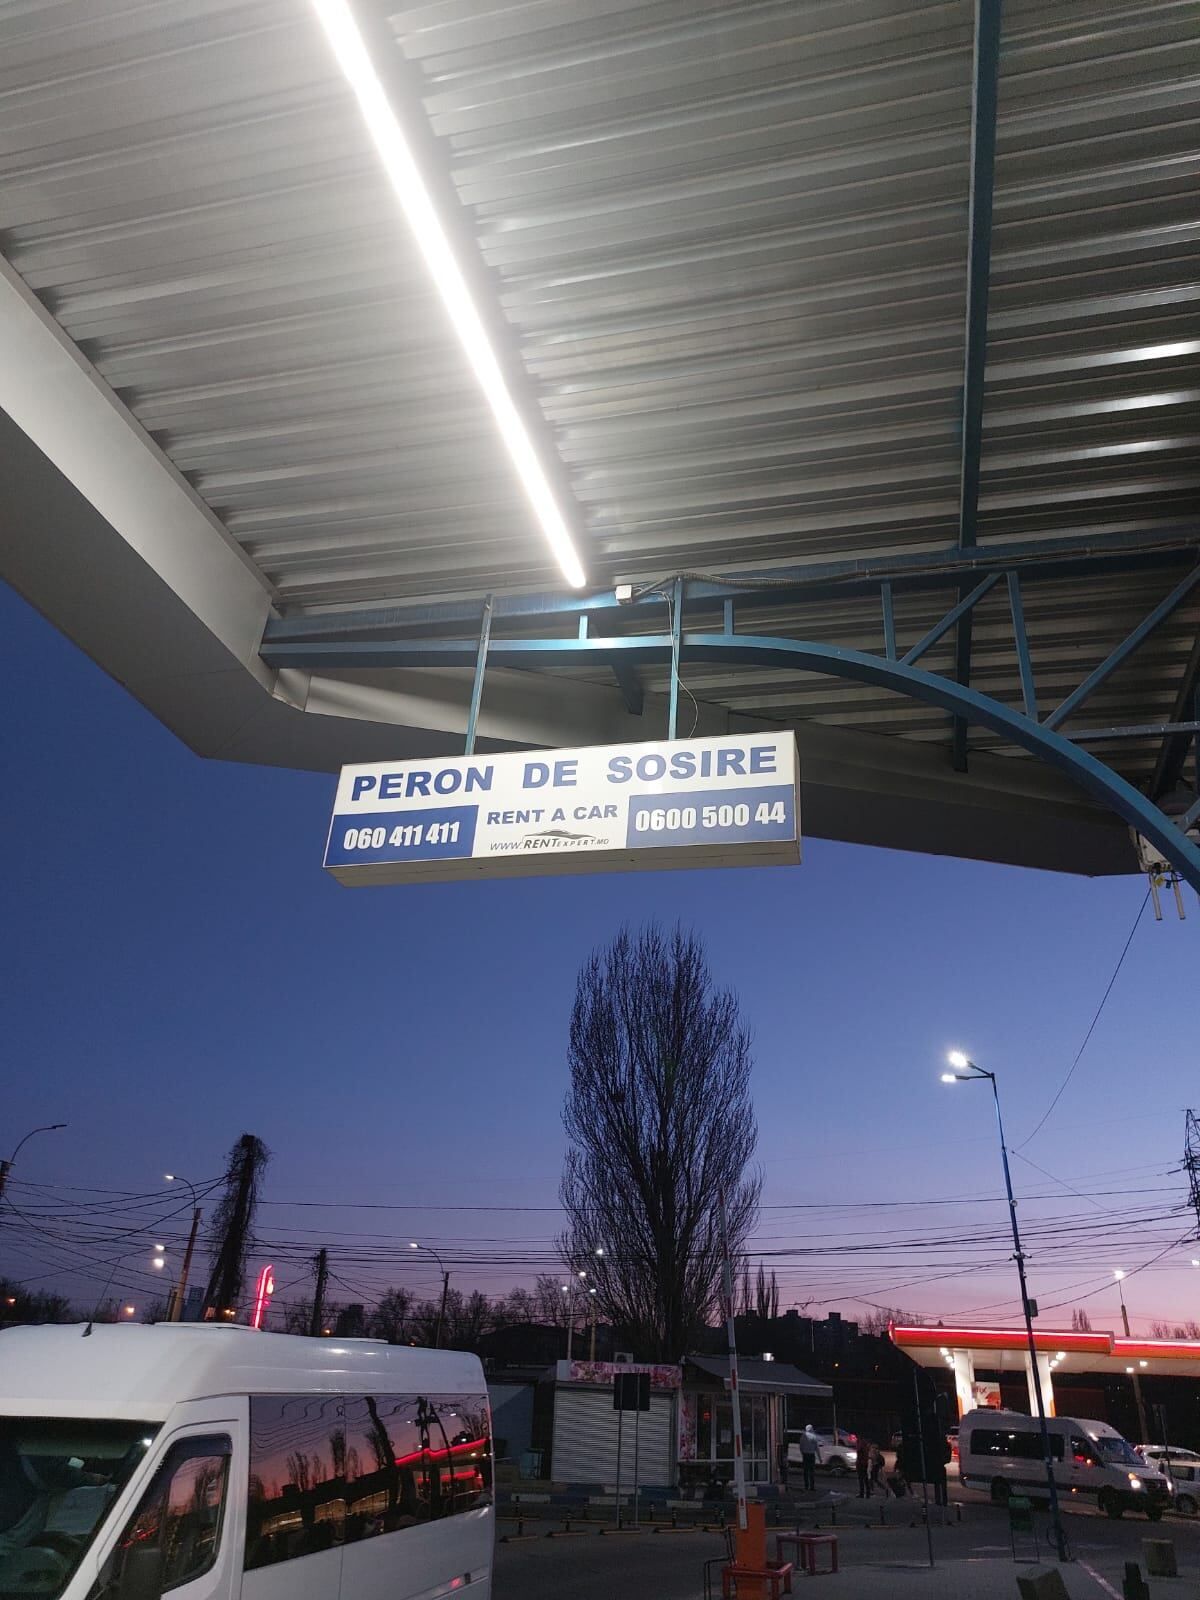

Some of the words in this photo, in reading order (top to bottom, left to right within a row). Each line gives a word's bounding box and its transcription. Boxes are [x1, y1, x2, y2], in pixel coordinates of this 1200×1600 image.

[351, 766, 494, 801] PERON
[522, 760, 578, 788] DE
[606, 746, 777, 783] SOSIRE
[487, 809, 545, 825] RENT
[551, 807, 566, 821] A
[573, 804, 618, 820] CAR
[635, 807, 697, 831] 0600
[702, 804, 749, 828] 500
[755, 801, 786, 824] 44
[343, 827, 386, 850] 060
[389, 824, 423, 846] 411
[425, 821, 460, 844] 411
